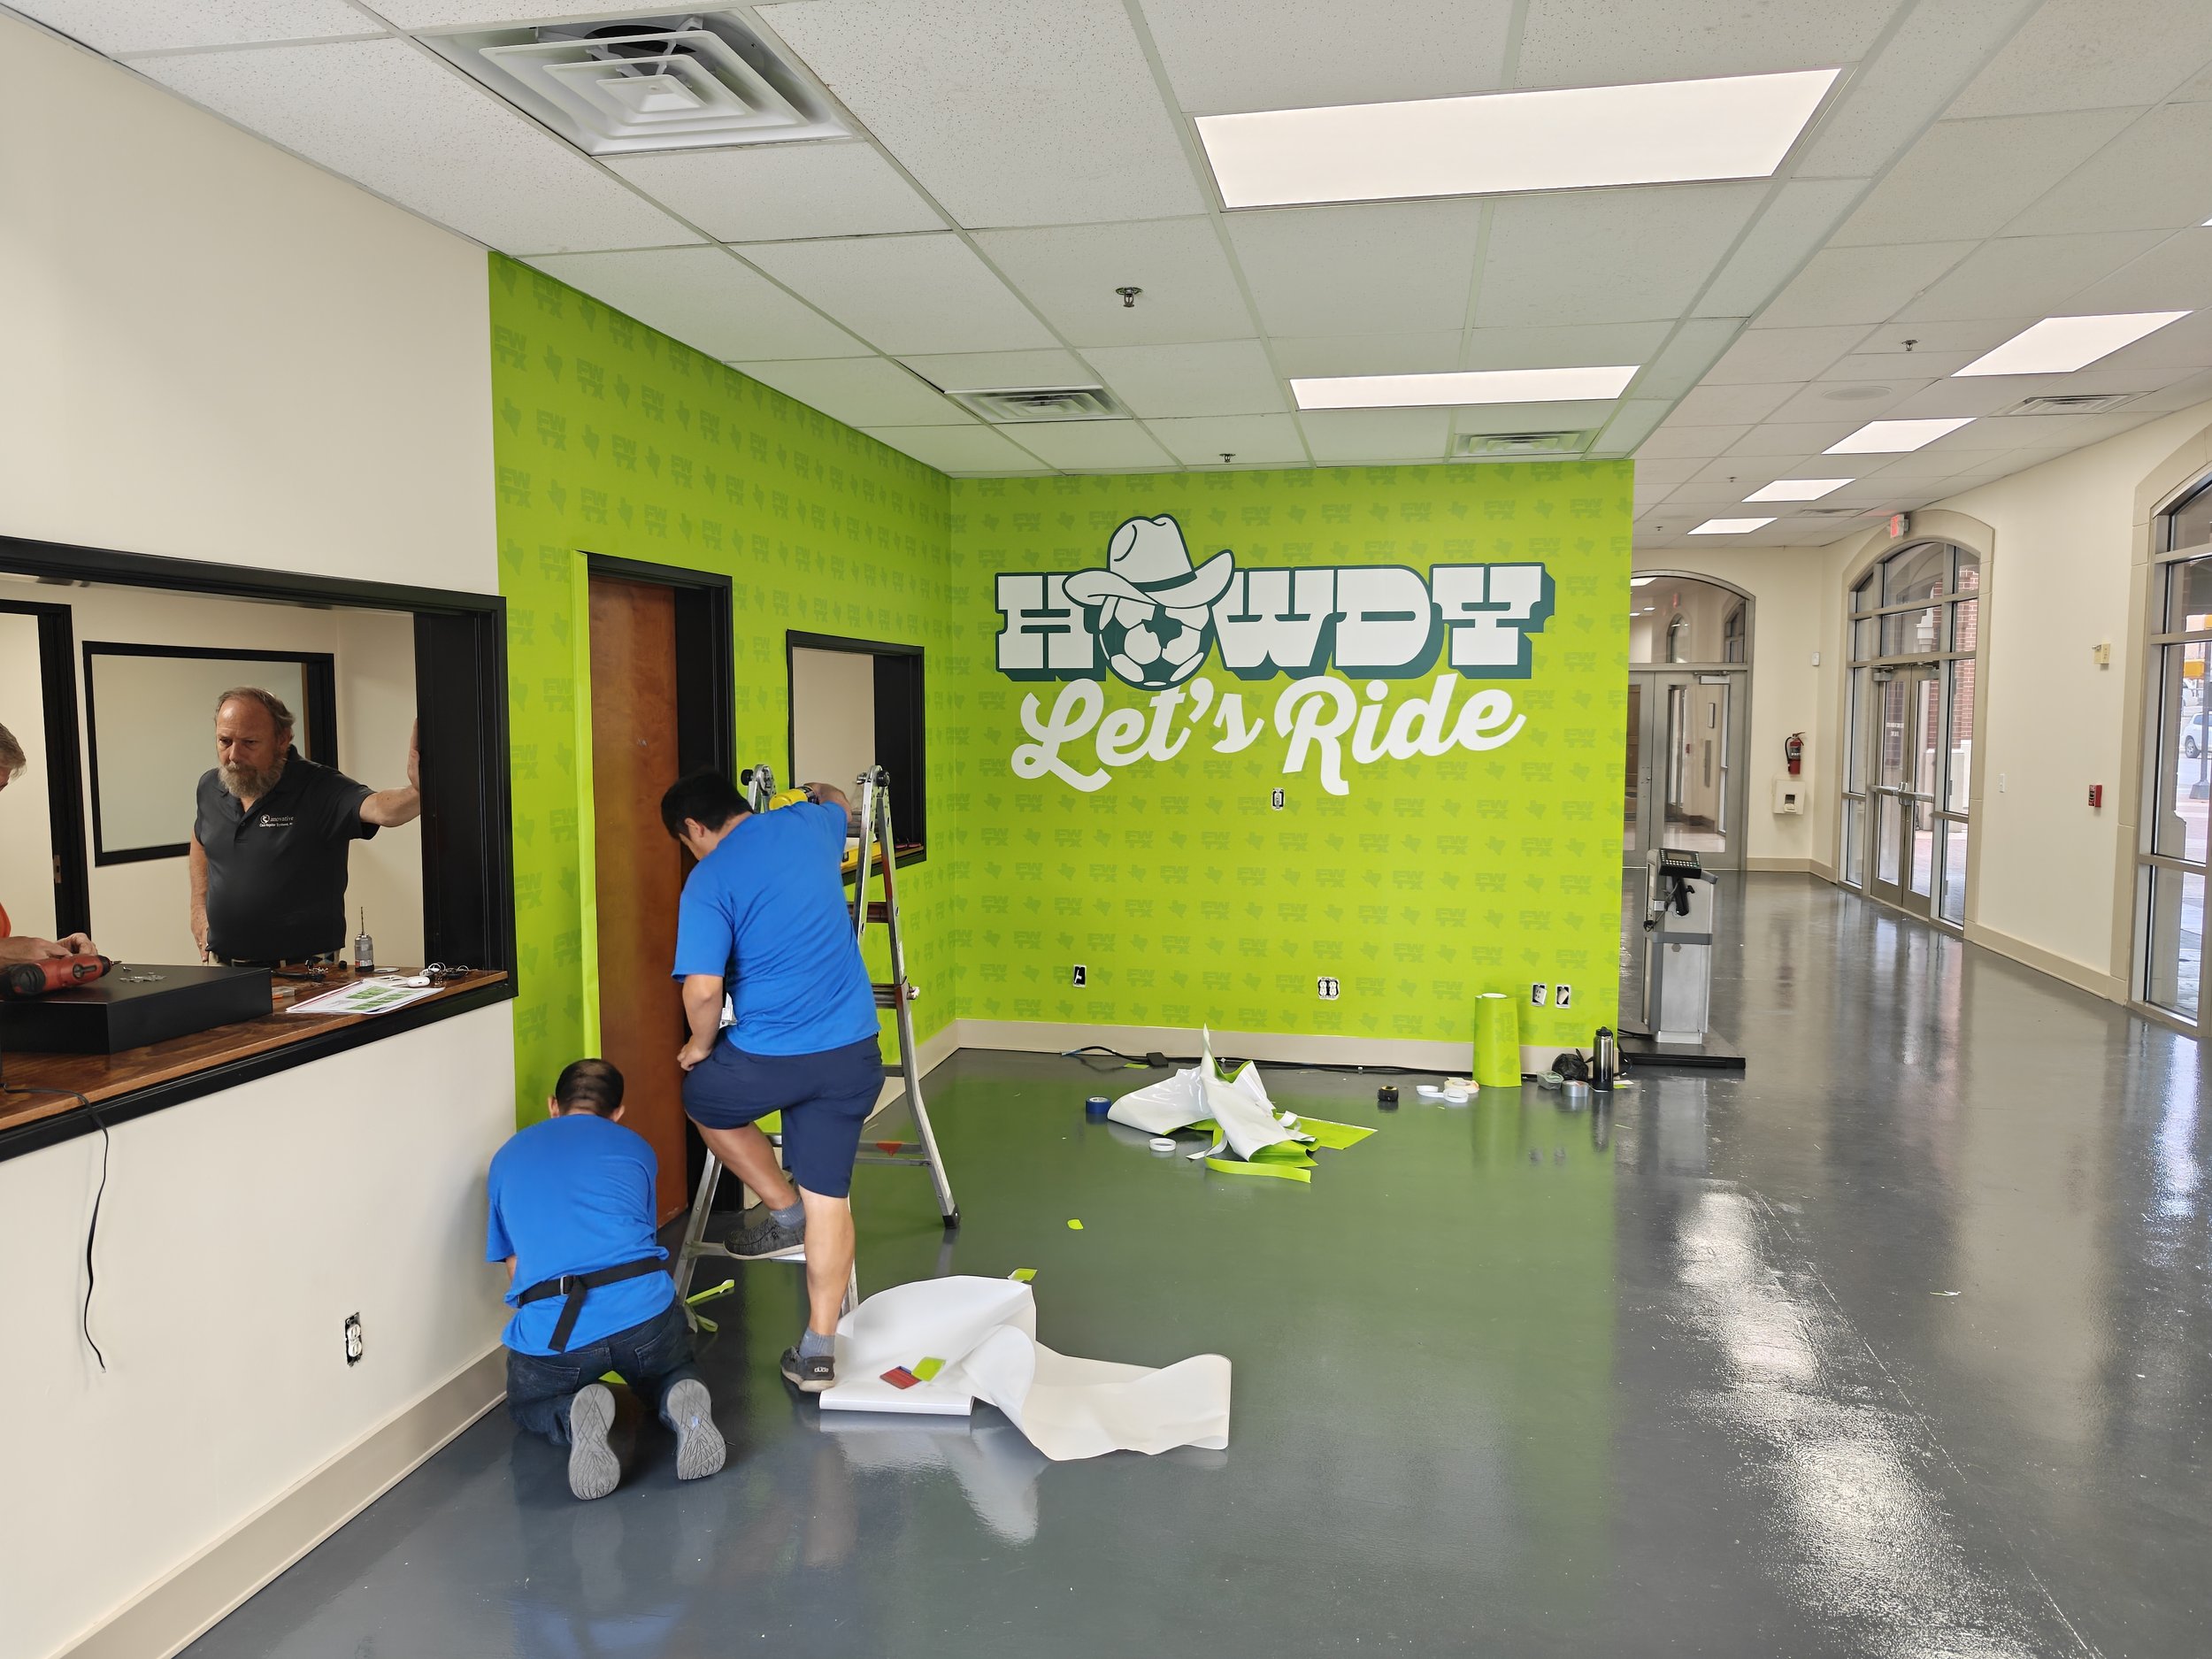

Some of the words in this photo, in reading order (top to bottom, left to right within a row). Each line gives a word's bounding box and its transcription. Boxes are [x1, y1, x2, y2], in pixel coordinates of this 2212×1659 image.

[495, 325, 526, 351] FW
[495, 343, 526, 372] TX
[577, 358, 604, 382] FW
[577, 375, 604, 400] TX
[641, 385, 664, 407] FW
[641, 401, 664, 423] TX
[537, 409, 566, 433] FW
[537, 426, 566, 451] TX
[612, 434, 636, 456] FW
[612, 449, 637, 472] TX
[498, 465, 530, 489] FW
[499, 484, 531, 508] TX
[580, 488, 608, 508] FW
[1321, 503, 1352, 513] FW
[1401, 502, 1432, 511] FW
[1484, 498, 1516, 510] FW
[1571, 498, 1602, 508] FW
[580, 504, 608, 525] TX
[644, 504, 667, 523] FW
[1241, 505, 1272, 516] FW
[1484, 510, 1515, 520] TX
[1571, 508, 1601, 518] TX
[1013, 512, 1041, 522] FW
[1241, 516, 1271, 526] TX
[1322, 513, 1351, 524] TX
[1401, 511, 1432, 522] TX
[645, 519, 667, 538] TX
[1013, 522, 1041, 532] TX
[1283, 542, 1313, 551] FW
[540, 546, 571, 565] FW
[979, 549, 1006, 558] FW
[1053, 548, 1081, 557] FW
[1283, 551, 1312, 562] TX
[979, 558, 1006, 569] TX
[1054, 557, 1080, 567] TX
[540, 563, 571, 582] TX
[995, 562, 1555, 688] HOWDY
[544, 679, 574, 694] FW
[545, 695, 574, 712] TX
[979, 700, 1005, 710] TX
[1010, 676, 1263, 793] Let's
[1274, 674, 1526, 795] Ride
[979, 758, 1006, 767] FW
[1203, 760, 1233, 769] FW
[979, 766, 1006, 777] TX
[1203, 769, 1232, 779] TX
[1015, 794, 1043, 803] FW
[1238, 796, 1267, 805] FW
[1317, 795, 1347, 806] FW
[1394, 798, 1425, 807] FW
[1016, 802, 1042, 812] TX
[1089, 803, 1117, 814] TX
[1161, 804, 1188, 814] TX
[1238, 805, 1267, 815] TX
[1317, 806, 1346, 817] TX
[1394, 807, 1425, 818] TX
[981, 828, 1009, 837] FW
[1125, 830, 1153, 839] FW
[1279, 833, 1308, 841] FW
[981, 836, 1008, 846] TX
[1055, 837, 1081, 848] TX
[1359, 833, 1389, 843] FW
[1521, 837, 1553, 847] FW
[1125, 839, 1153, 849] TX
[1279, 841, 1308, 851] TX
[1359, 842, 1388, 853] TX
[1521, 846, 1552, 856] TX
[1016, 863, 1043, 872] FW
[1089, 864, 1118, 872] FW
[1237, 867, 1265, 876] FW
[1016, 871, 1042, 880] TX
[1090, 872, 1117, 882] TX
[1316, 869, 1346, 878] FW
[1475, 872, 1507, 882] FW
[1237, 876, 1265, 886] TX
[1316, 877, 1345, 887] TX
[1476, 881, 1506, 892] TX
[982, 895, 1009, 904] FW
[1055, 897, 1082, 906] FW
[981, 903, 1008, 913] TX
[1055, 905, 1082, 916] TX
[1201, 901, 1230, 910] FW
[1278, 903, 1308, 912] FW
[1358, 905, 1388, 916] FW
[1201, 910, 1229, 920] TX
[1279, 911, 1307, 922] TX
[1359, 914, 1387, 925] TX
[1519, 910, 1550, 920] FW
[1519, 920, 1550, 930] TX
[1014, 931, 1041, 940] FW
[1162, 935, 1190, 945] FW
[1014, 939, 1041, 949] TX
[1239, 938, 1267, 948] FW
[1313, 941, 1343, 950] FW
[1163, 943, 1189, 954] TX
[1239, 947, 1267, 957] TX
[1471, 946, 1503, 956] FW
[1556, 949, 1587, 958] FW
[1313, 949, 1342, 960] TX
[1471, 955, 1502, 965] TX
[1556, 958, 1587, 969] TX
[980, 964, 1007, 972] FW
[980, 972, 1007, 982] TX
[1126, 969, 1155, 978] FW
[1127, 977, 1154, 987] TX
[1276, 974, 1305, 984] FW
[1276, 983, 1305, 994] TX
[1432, 980, 1463, 990] FW
[1432, 990, 1462, 1001] TX
[1087, 1002, 1116, 1011] FW
[1162, 1004, 1191, 1014] FW
[517, 1003, 548, 1027] FW
[1087, 1010, 1115, 1020] TX
[1162, 1012, 1189, 1024] TX
[1238, 1008, 1267, 1018] FW
[1312, 1010, 1342, 1021] FW
[1239, 1017, 1267, 1027] TX
[1313, 1019, 1342, 1030] TX
[1555, 1022, 1586, 1032] FW
[518, 1019, 548, 1046] TX
[1555, 1031, 1586, 1044] TX
